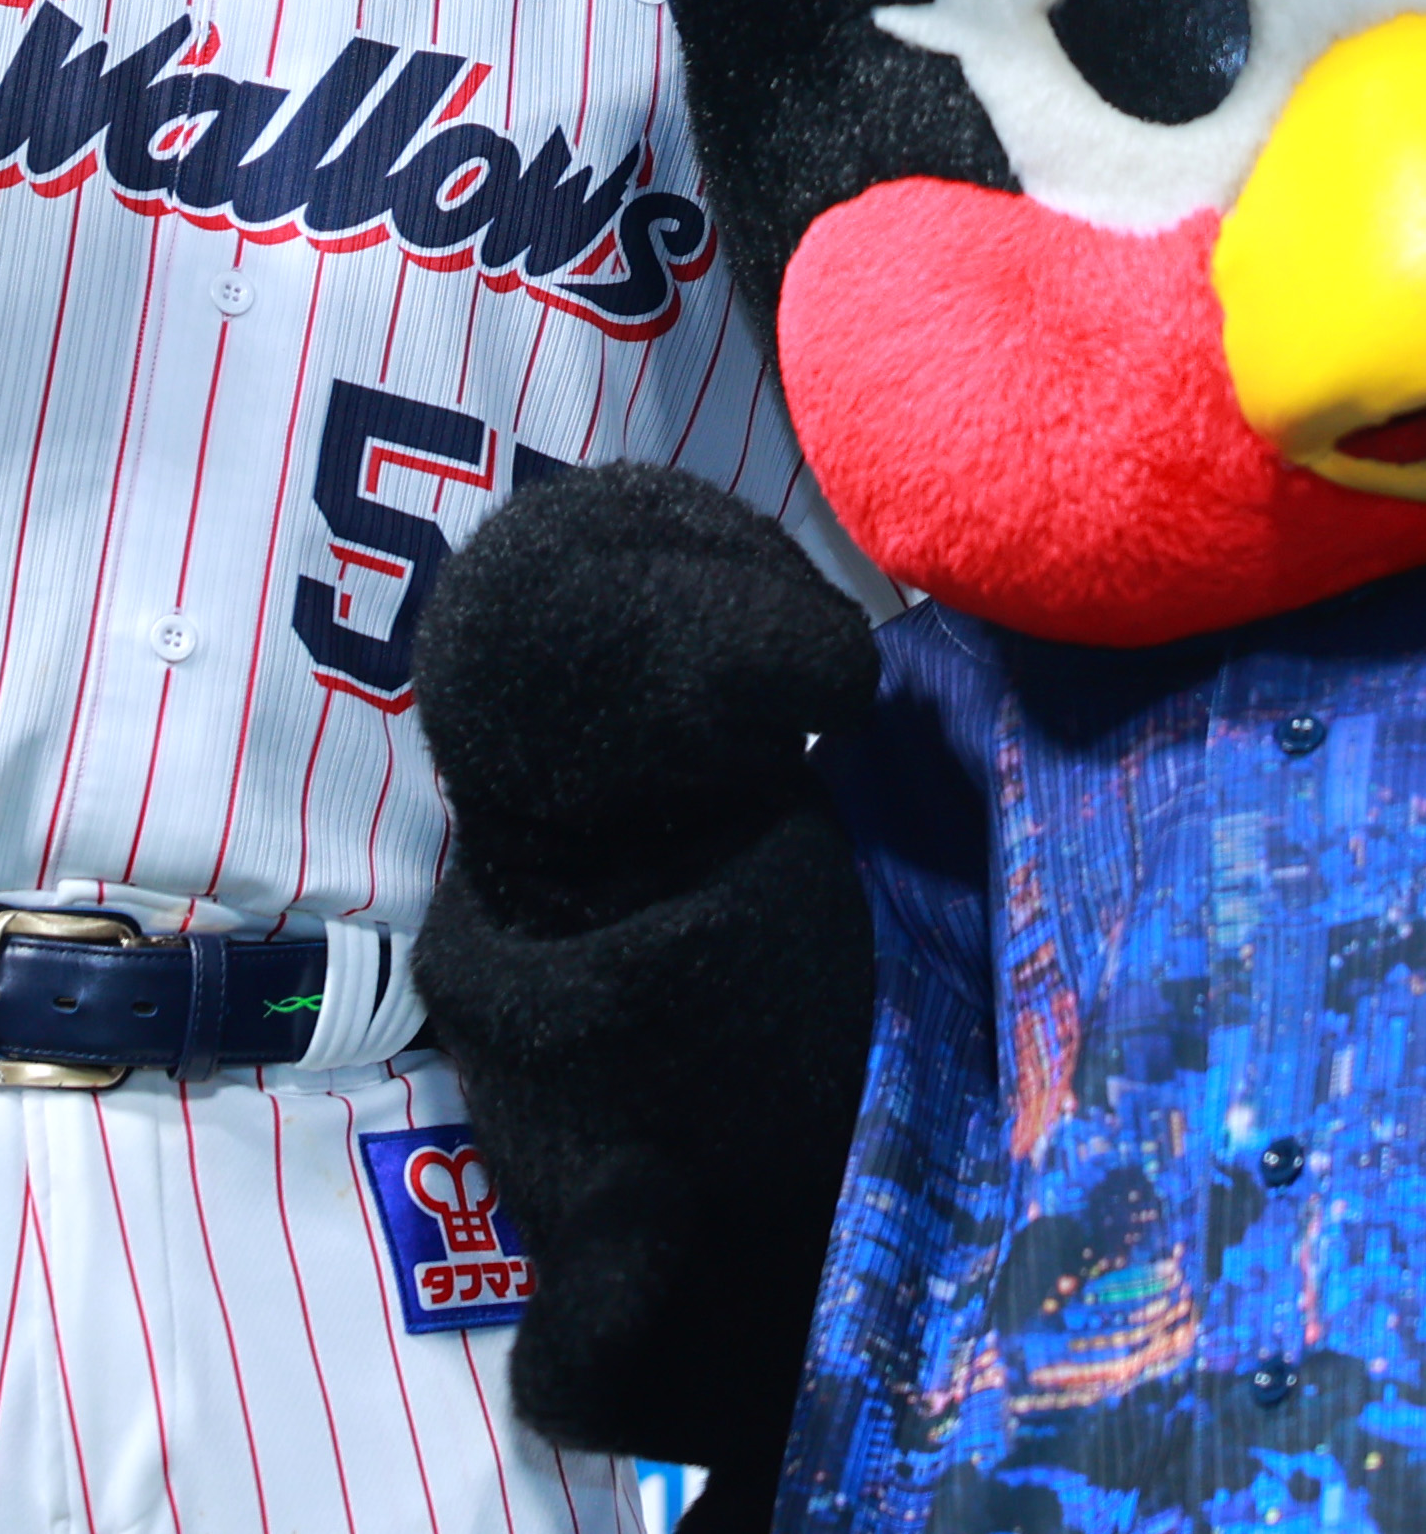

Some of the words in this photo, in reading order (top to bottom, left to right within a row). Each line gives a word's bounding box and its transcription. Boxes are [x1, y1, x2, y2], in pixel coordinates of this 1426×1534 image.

[292, 378, 581, 715] 5
[421, 1260, 538, 1305] タフマン
